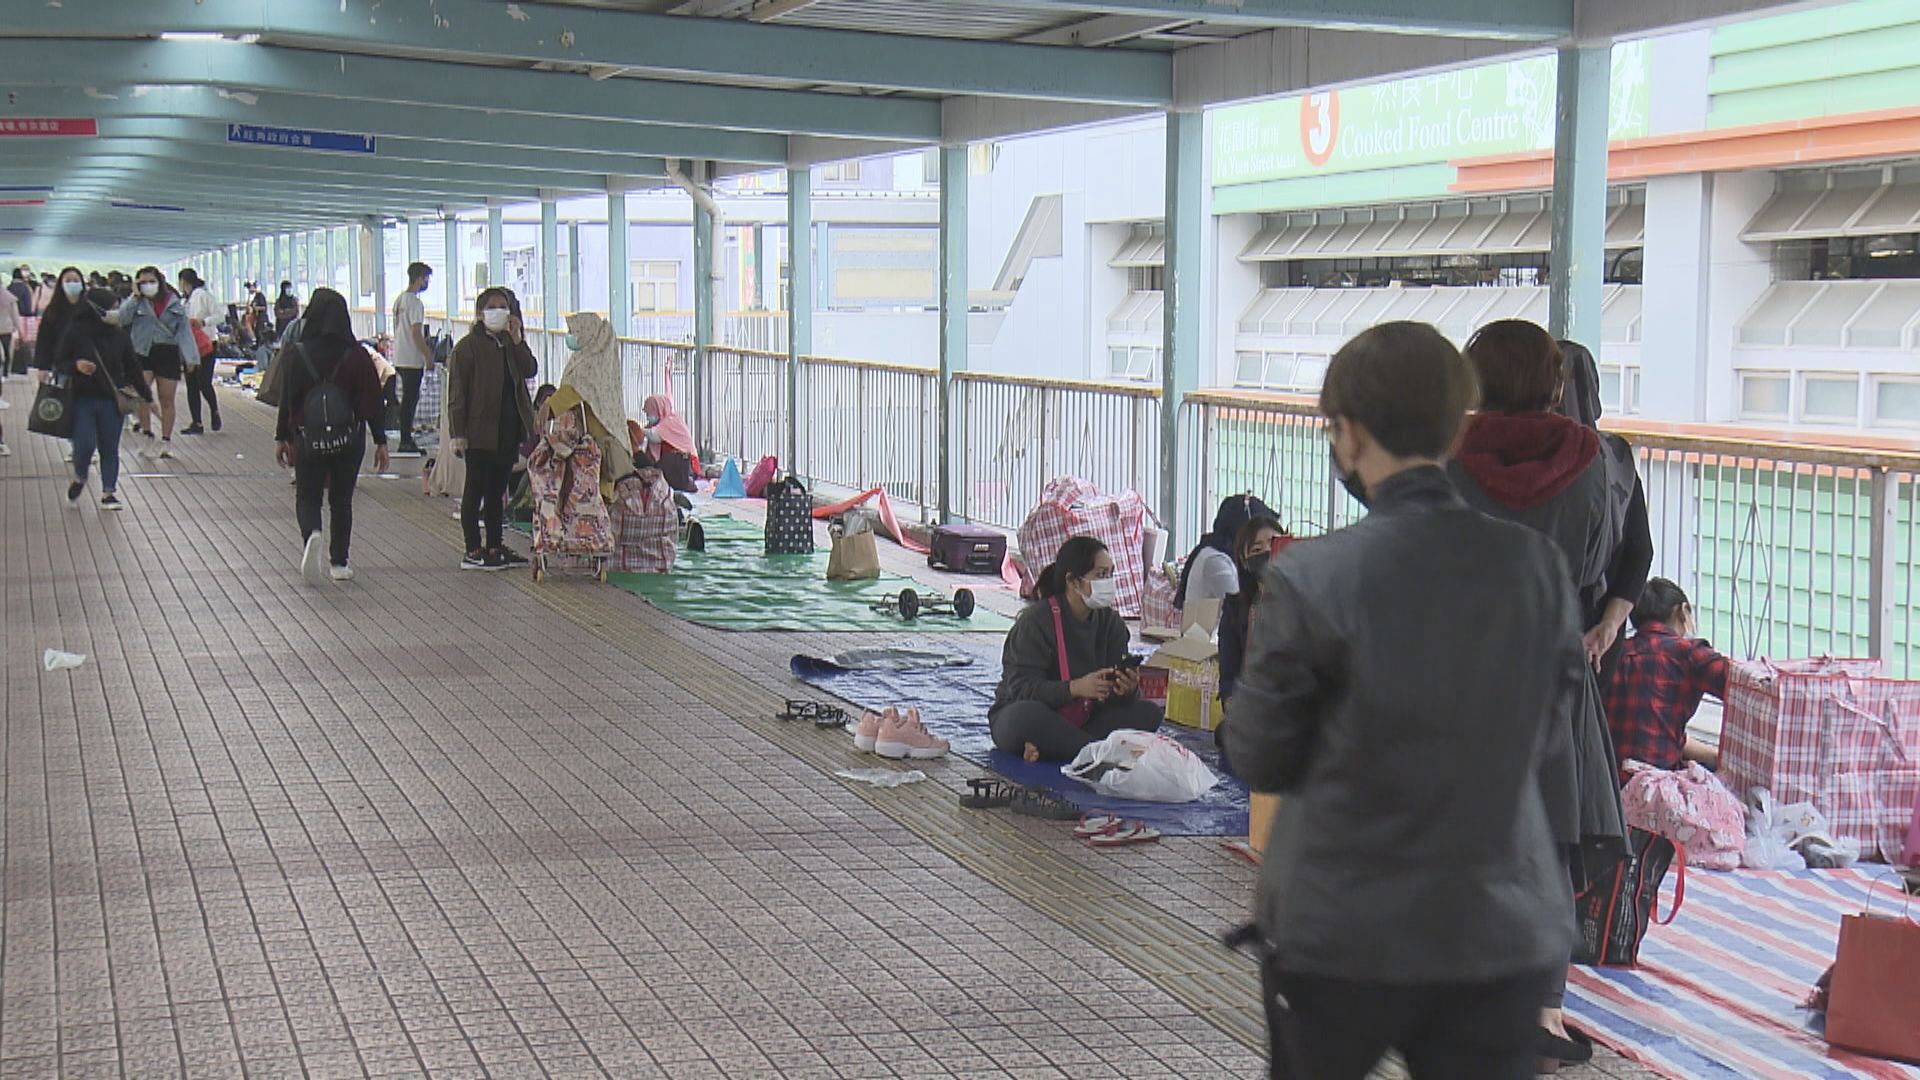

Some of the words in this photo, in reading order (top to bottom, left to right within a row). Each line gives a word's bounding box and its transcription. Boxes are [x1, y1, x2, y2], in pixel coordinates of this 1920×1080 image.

[1308, 91, 1331, 155] 3
[1341, 115, 1403, 158] Cooked
[1407, 107, 1451, 150] Food
[1456, 106, 1520, 145] Centre
